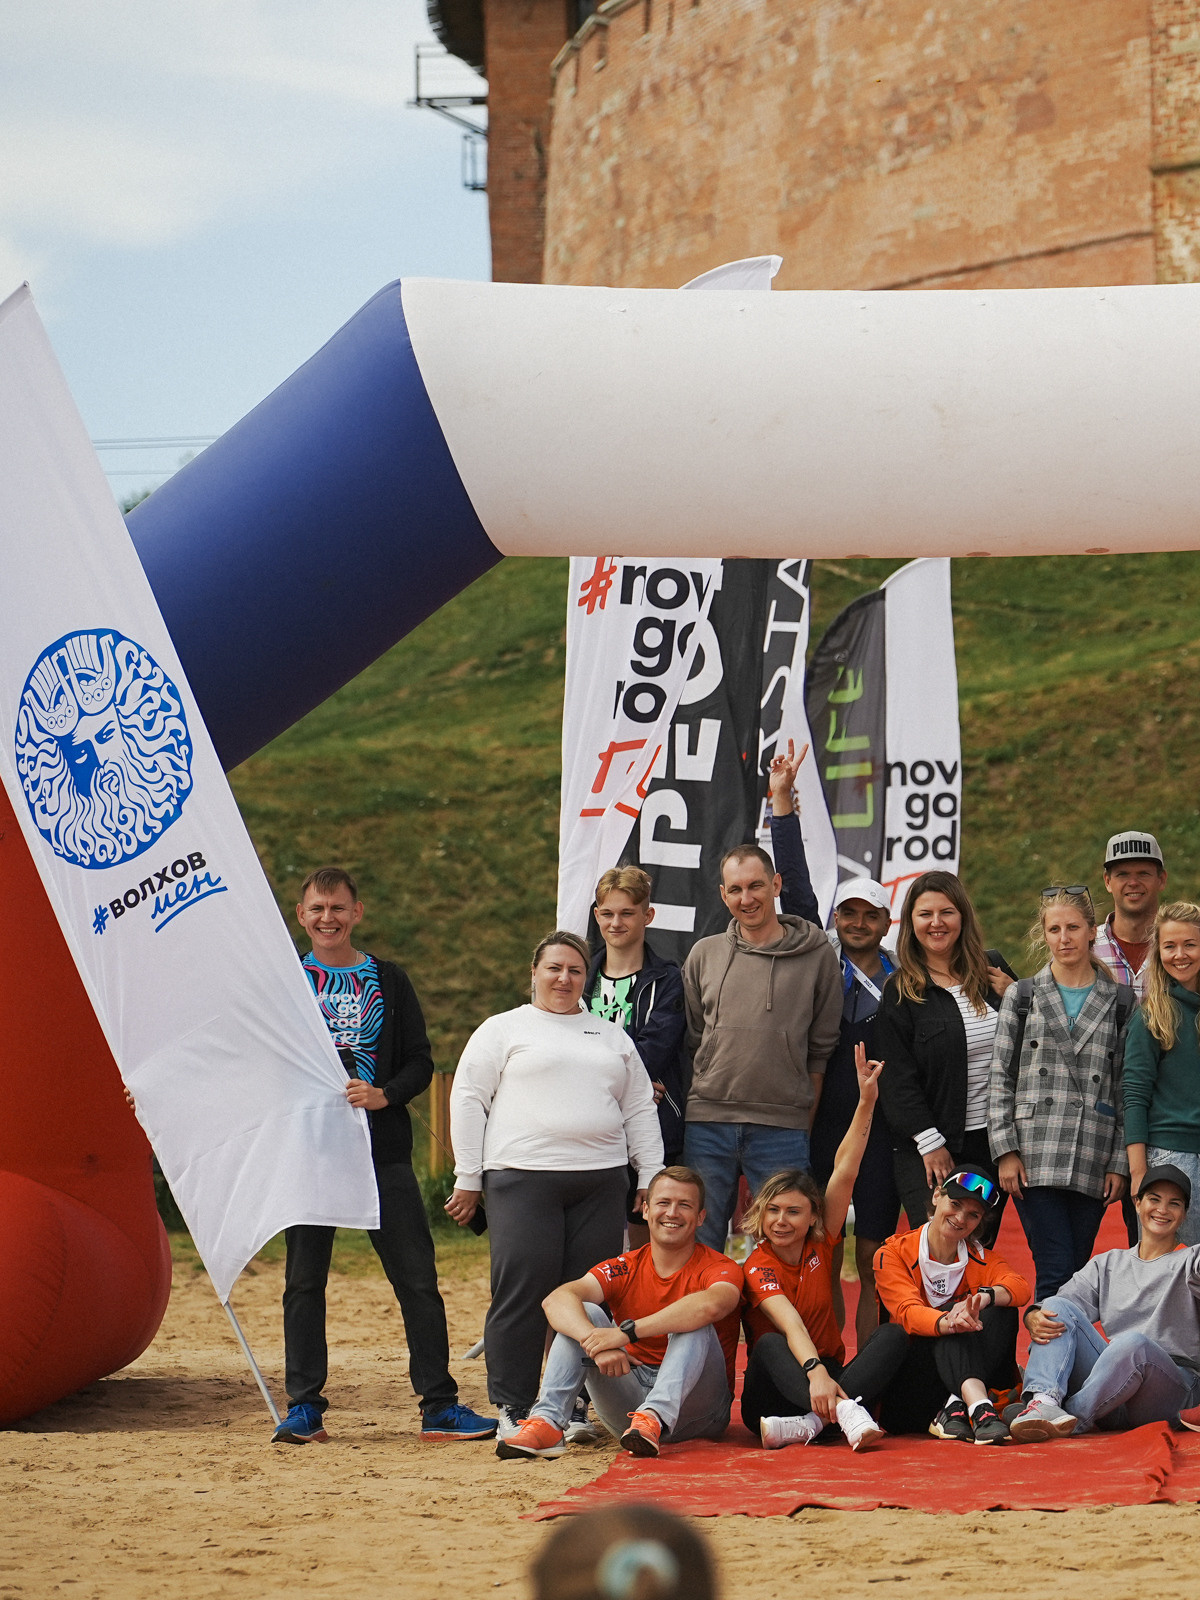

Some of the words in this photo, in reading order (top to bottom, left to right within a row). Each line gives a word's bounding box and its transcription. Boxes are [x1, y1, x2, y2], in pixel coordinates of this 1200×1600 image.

[905, 792, 958, 831] go
[885, 820, 957, 861] rod
[1112, 840, 1151, 857] PUMA
[93, 852, 206, 935] #ВОЛХОВ
[151, 872, 222, 919] мен
[315, 991, 362, 1003] #nov
[338, 1002, 361, 1017] go
[329, 1013, 361, 1028] rod
